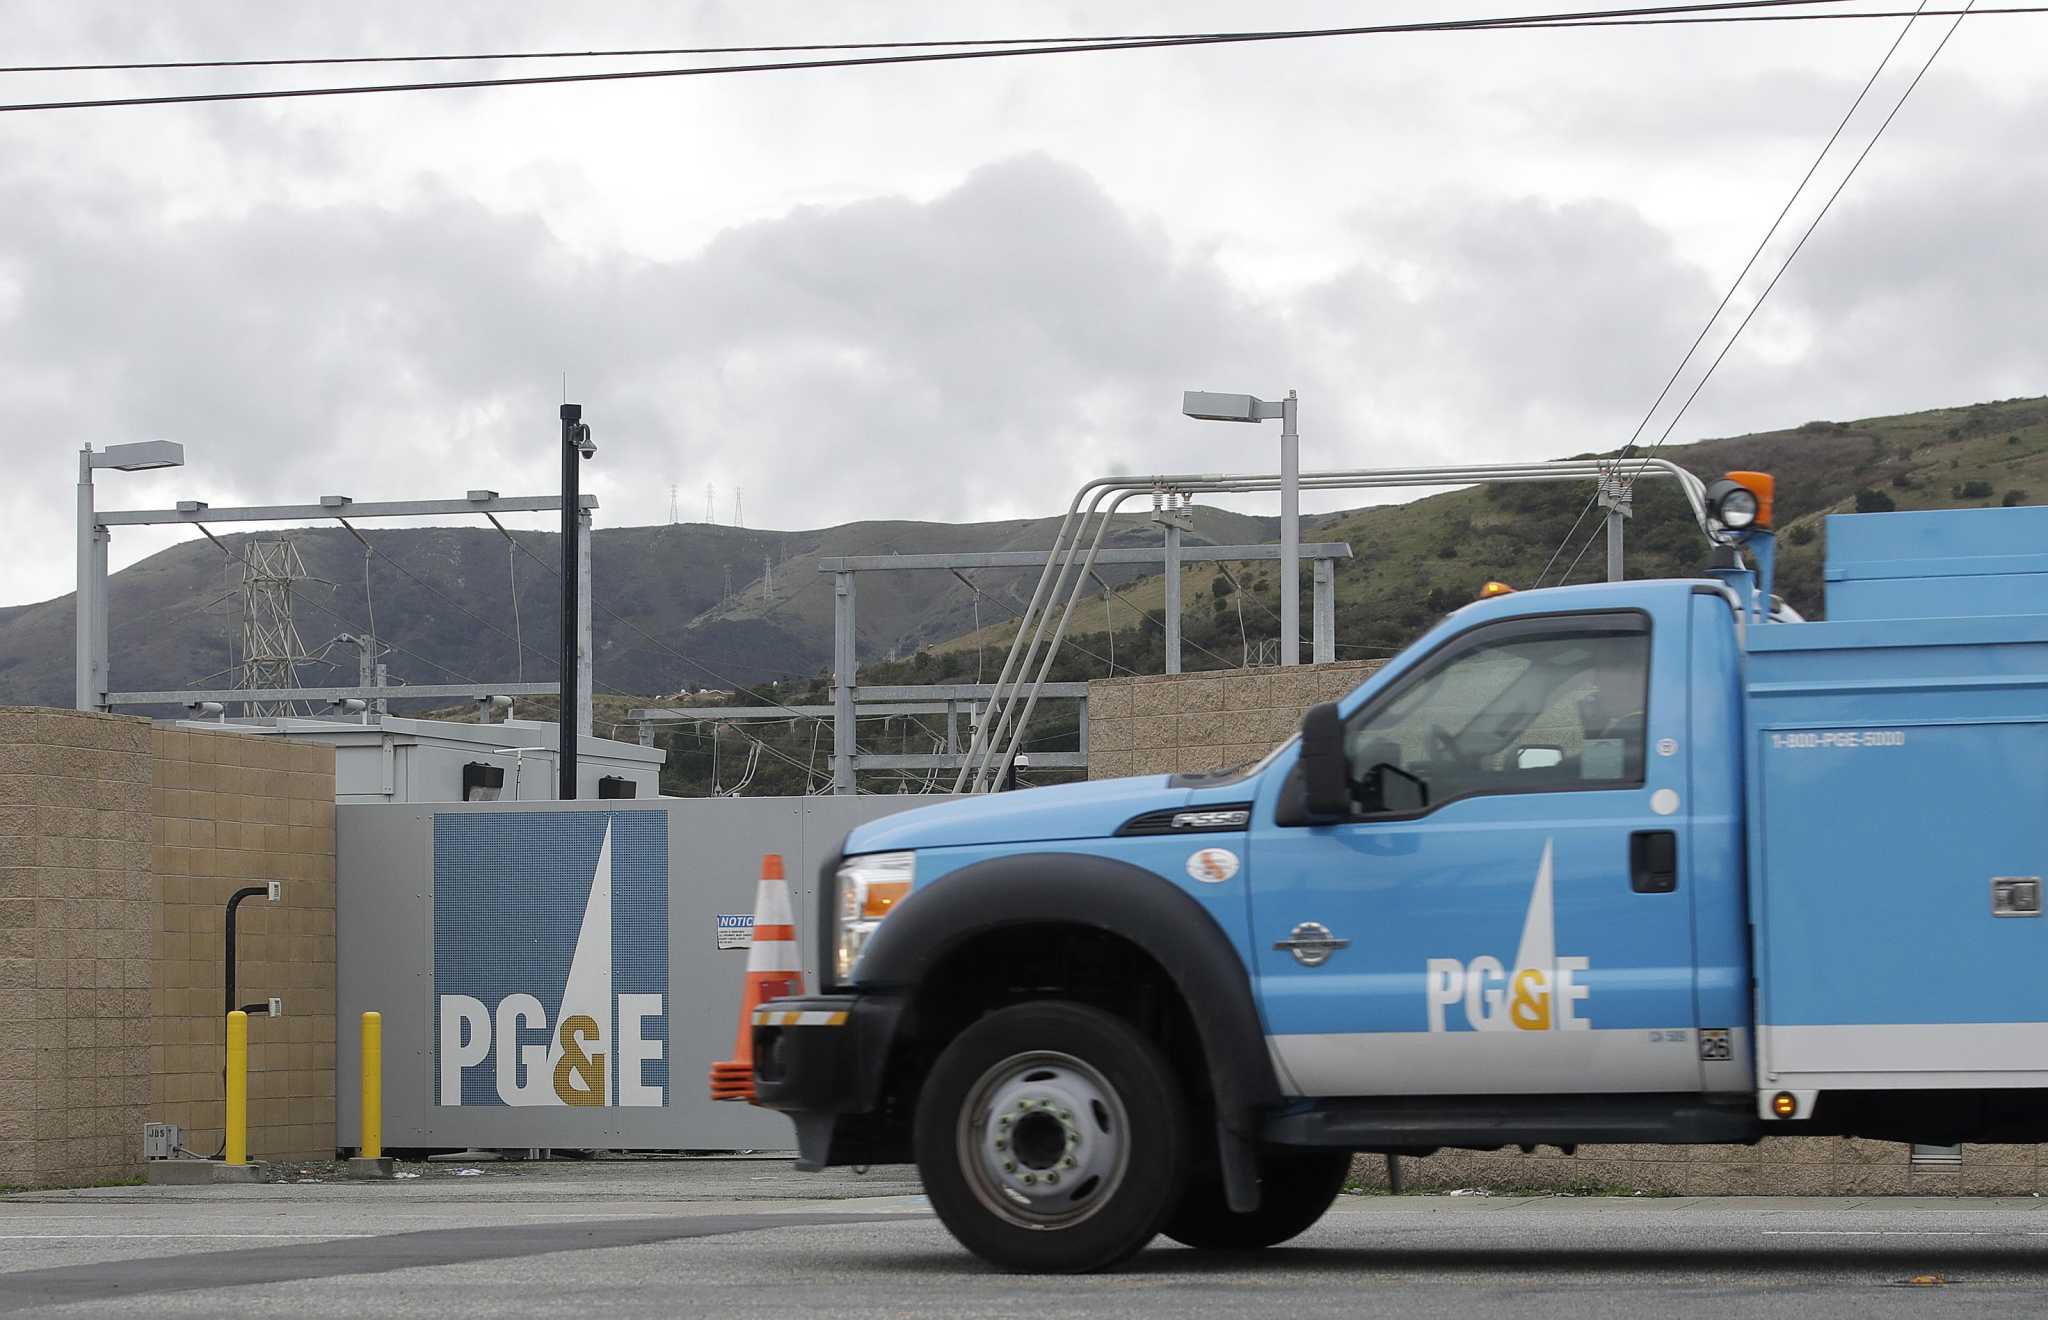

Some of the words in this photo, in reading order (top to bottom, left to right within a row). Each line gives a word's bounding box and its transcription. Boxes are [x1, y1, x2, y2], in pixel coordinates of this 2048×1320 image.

[720, 916, 754, 927] NOTIC
[1426, 954, 1592, 1032] PG&E
[440, 993, 664, 1107] PG&E
